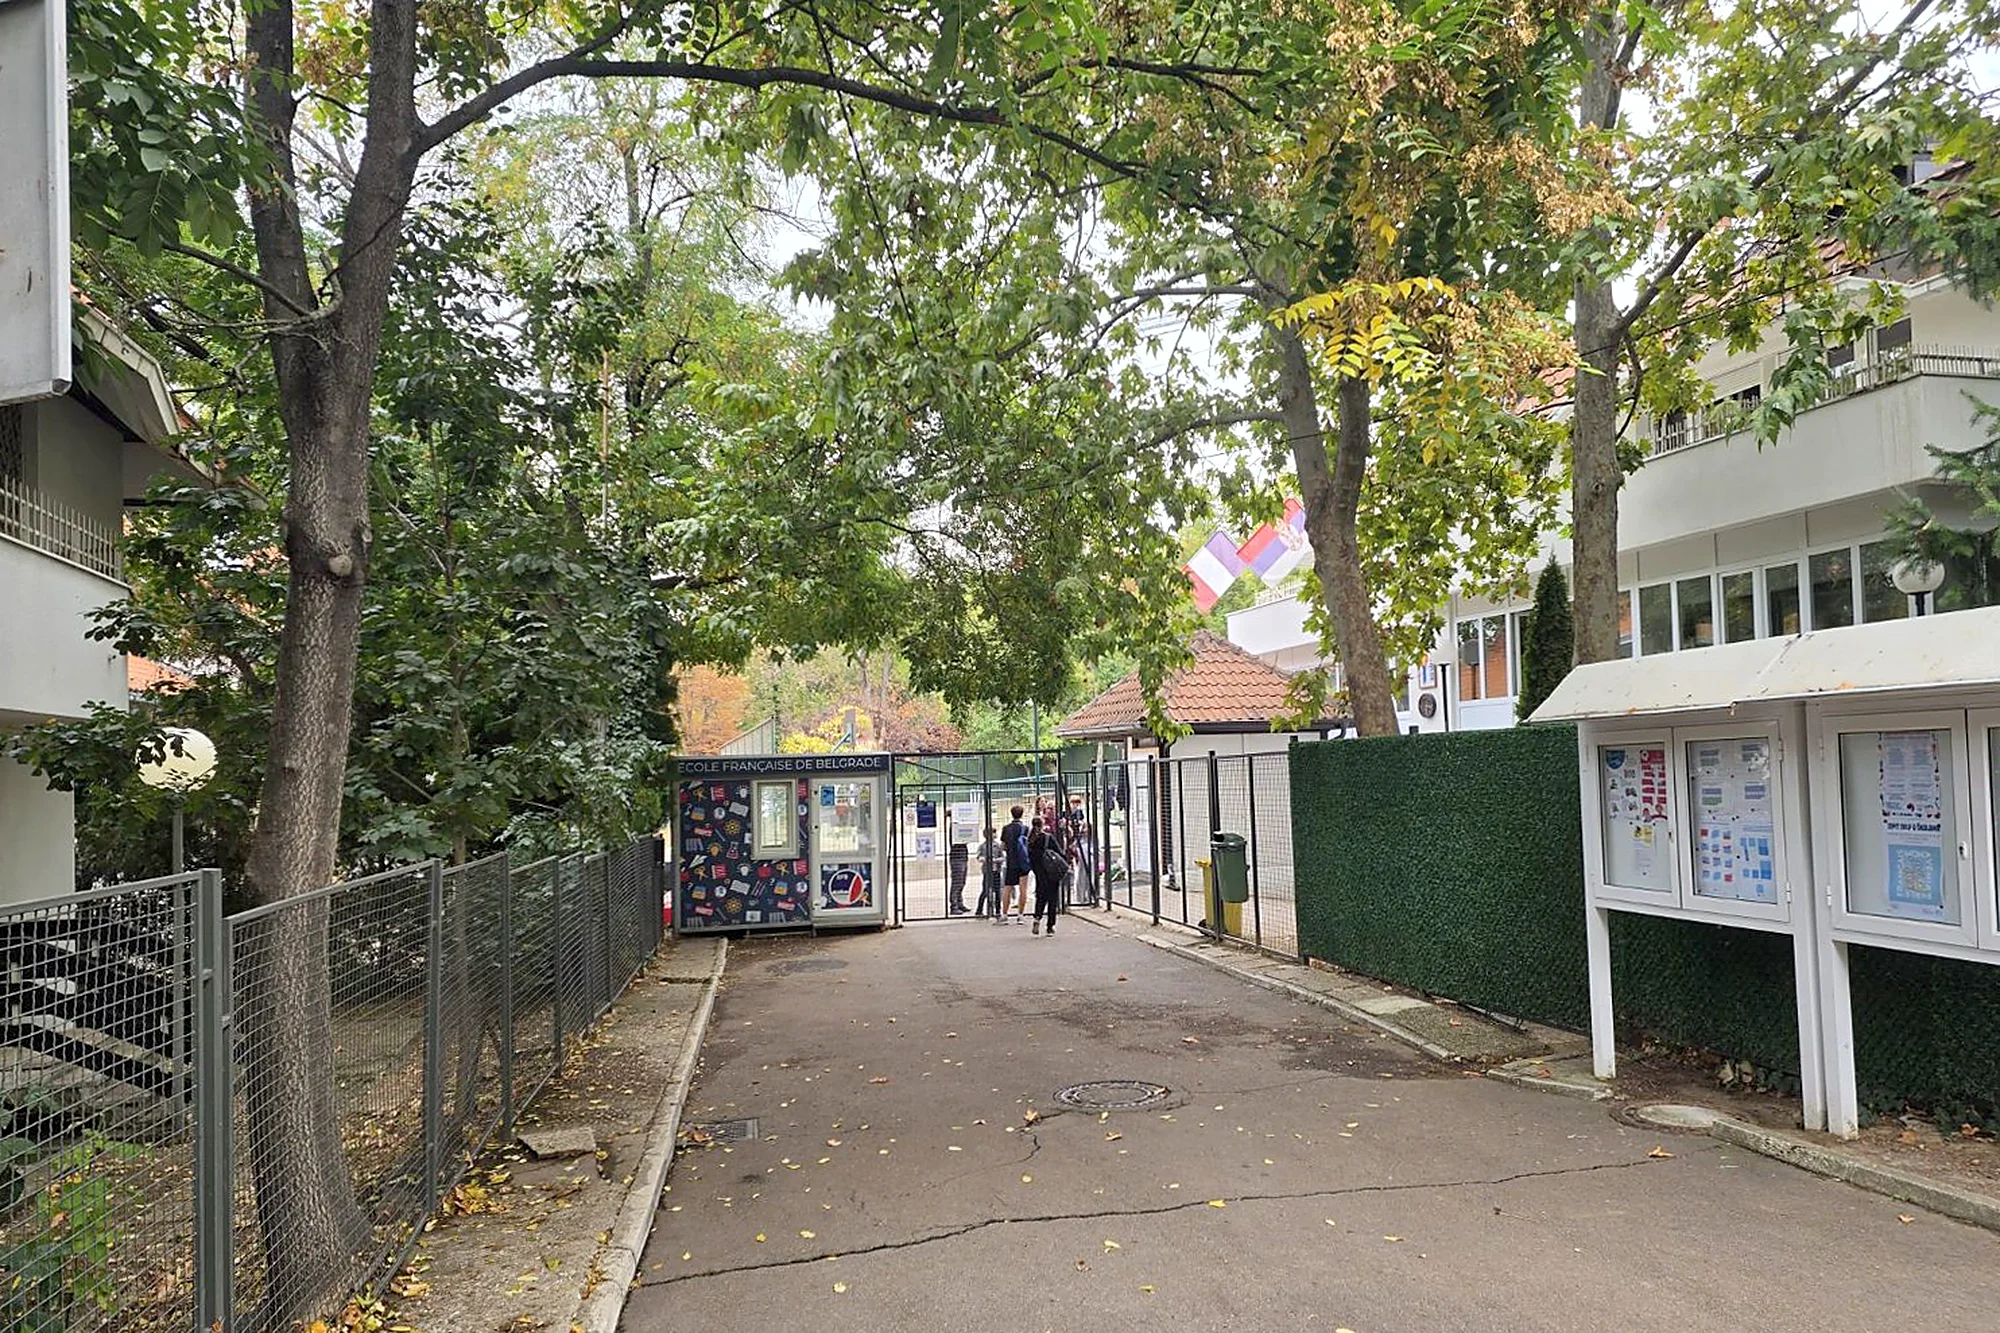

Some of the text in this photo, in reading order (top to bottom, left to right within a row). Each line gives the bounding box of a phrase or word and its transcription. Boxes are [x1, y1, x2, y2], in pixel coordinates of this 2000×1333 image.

[723, 760, 793, 773] FRANÇAISE
[796, 759, 813, 770] DE
[816, 757, 881, 769] BELGRADE
